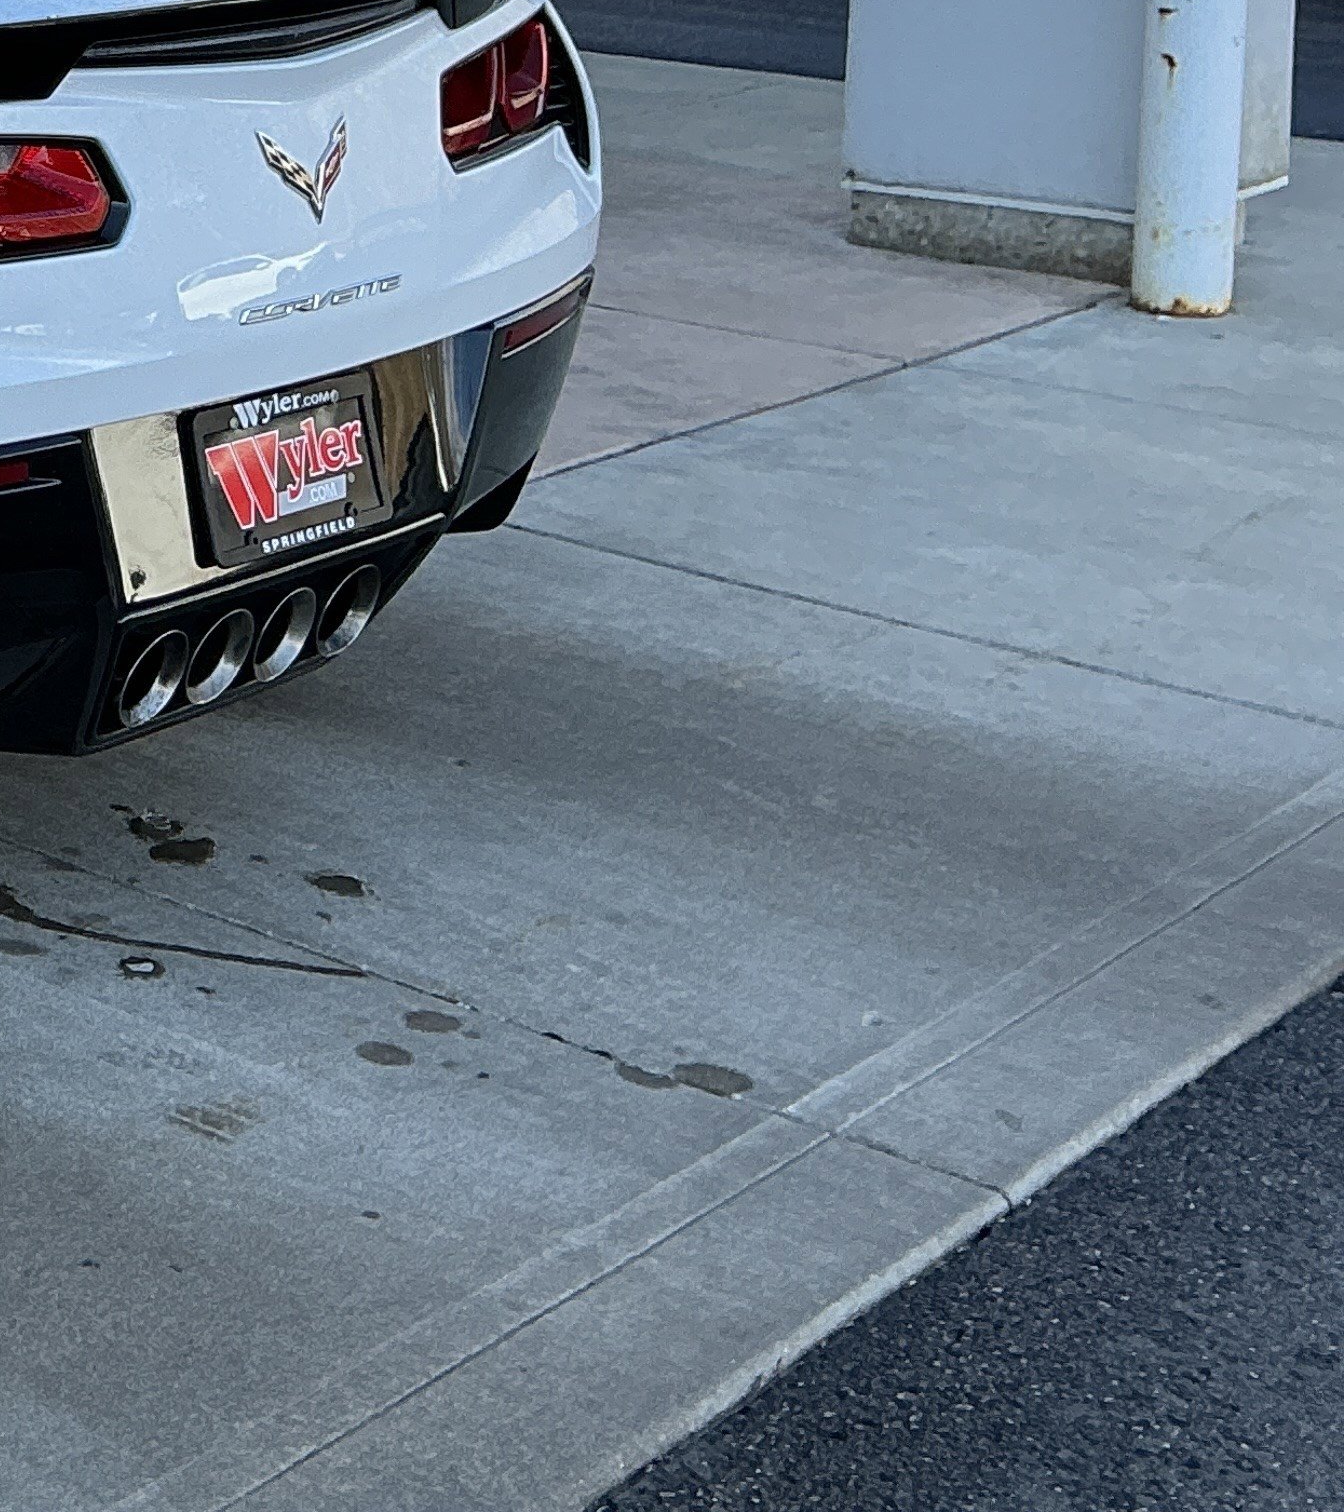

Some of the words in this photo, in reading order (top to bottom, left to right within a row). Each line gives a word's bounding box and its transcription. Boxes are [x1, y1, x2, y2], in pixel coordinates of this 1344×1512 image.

[238, 273, 403, 326] CORVETTE
[204, 416, 363, 531] Wyler
[261, 515, 356, 554] SPRINGFIELD
